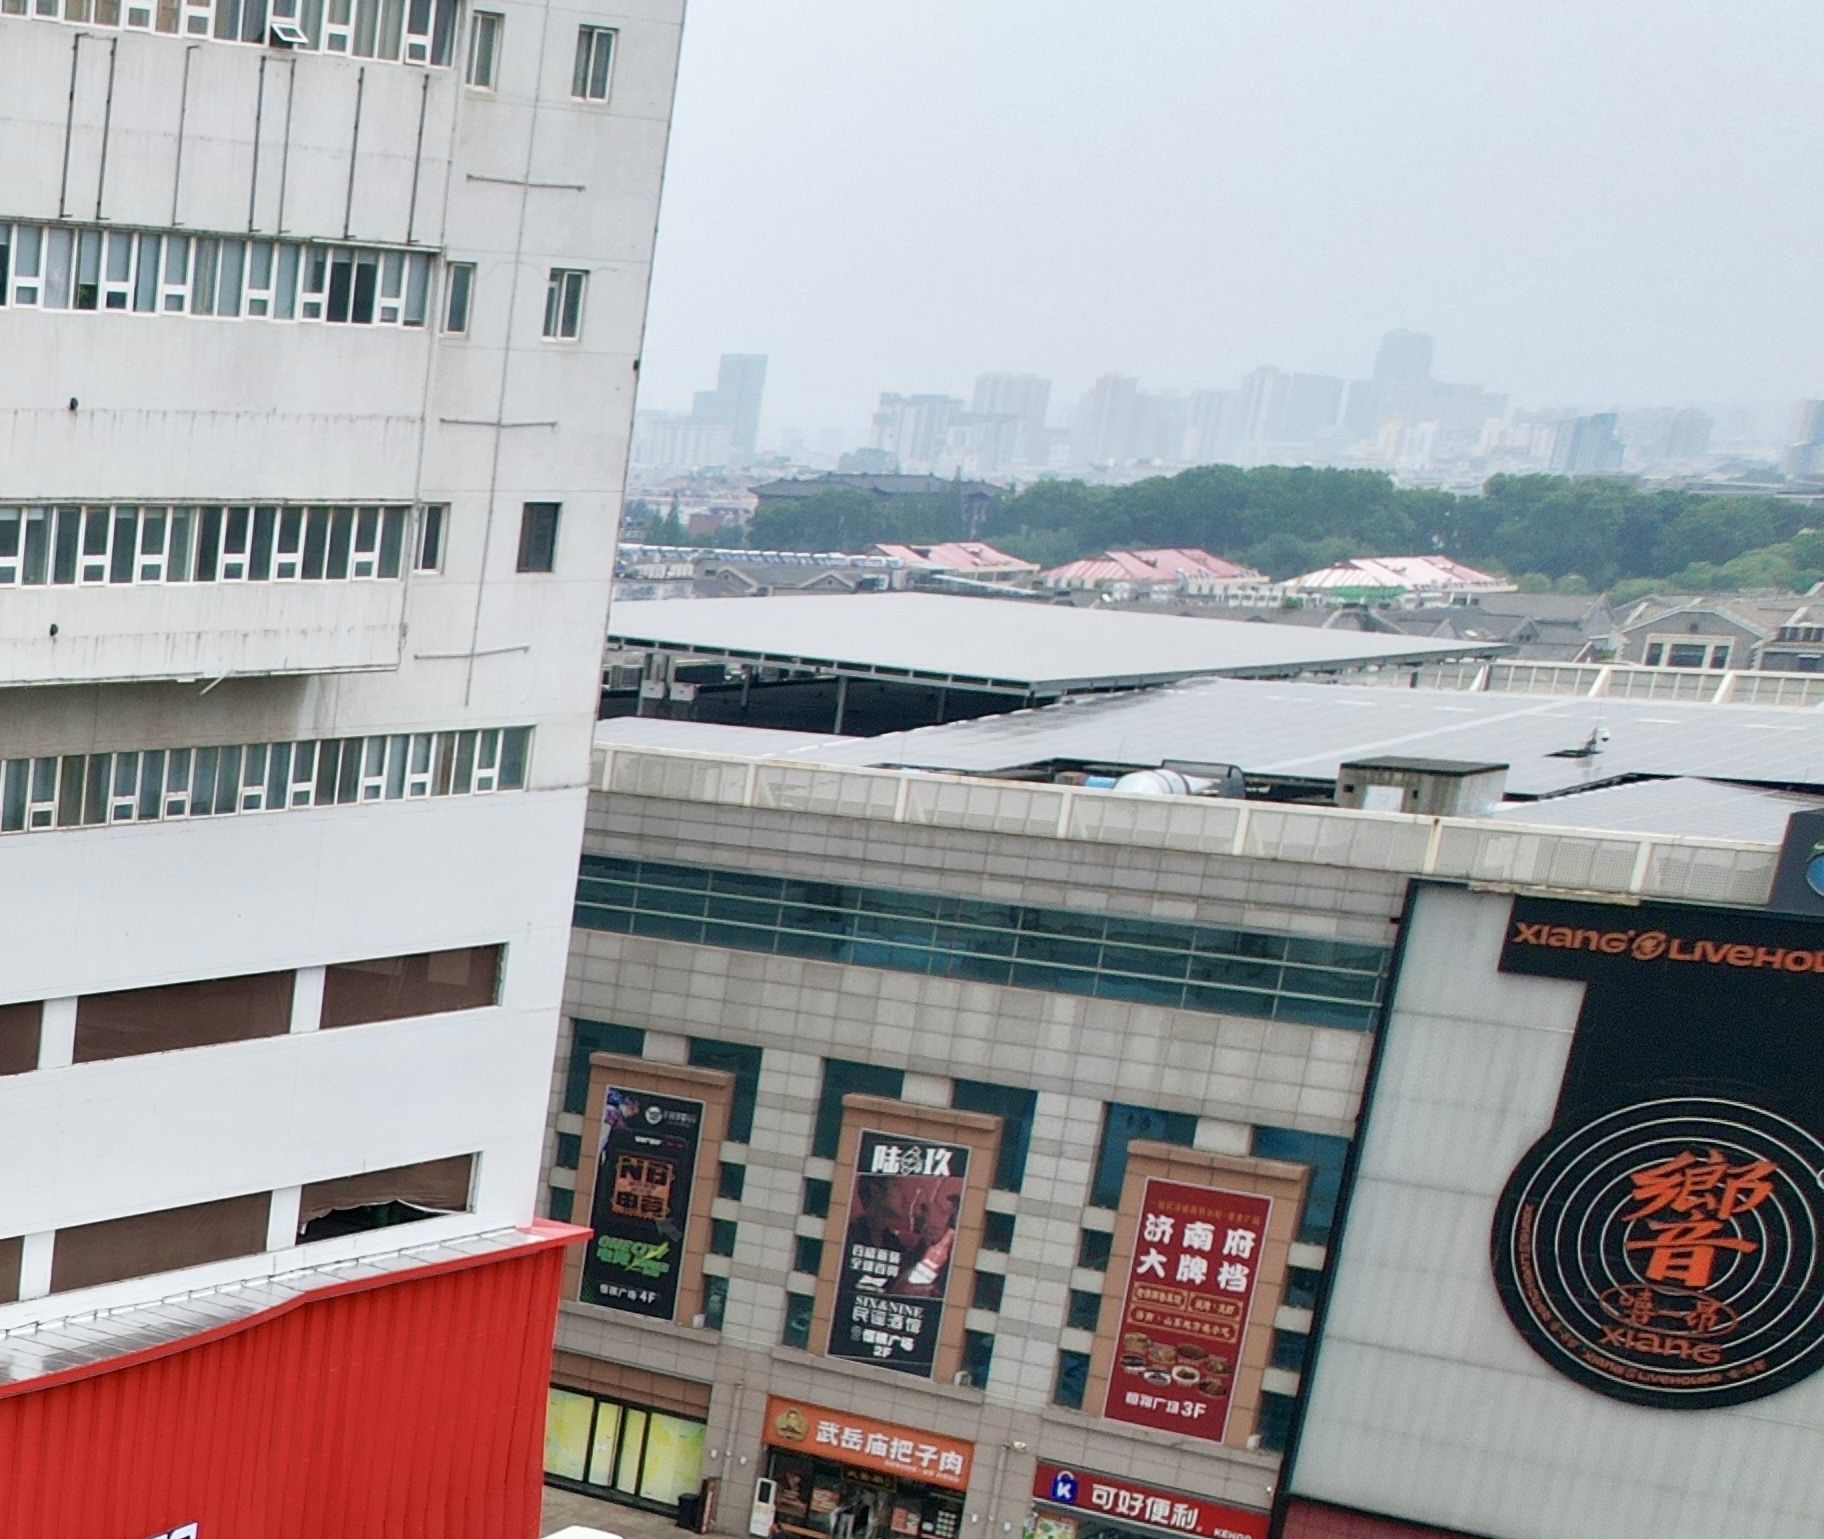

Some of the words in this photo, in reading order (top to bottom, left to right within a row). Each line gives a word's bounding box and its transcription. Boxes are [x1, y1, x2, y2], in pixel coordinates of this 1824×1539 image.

[1143, 1213, 1257, 1260] 济南府
[1136, 1248, 1251, 1294] 大牌档
[1180, 1402, 1207, 1419] 3F
[815, 1420, 964, 1475] 武岳庙把子肉
[1092, 1484, 1200, 1531] 可好便利
